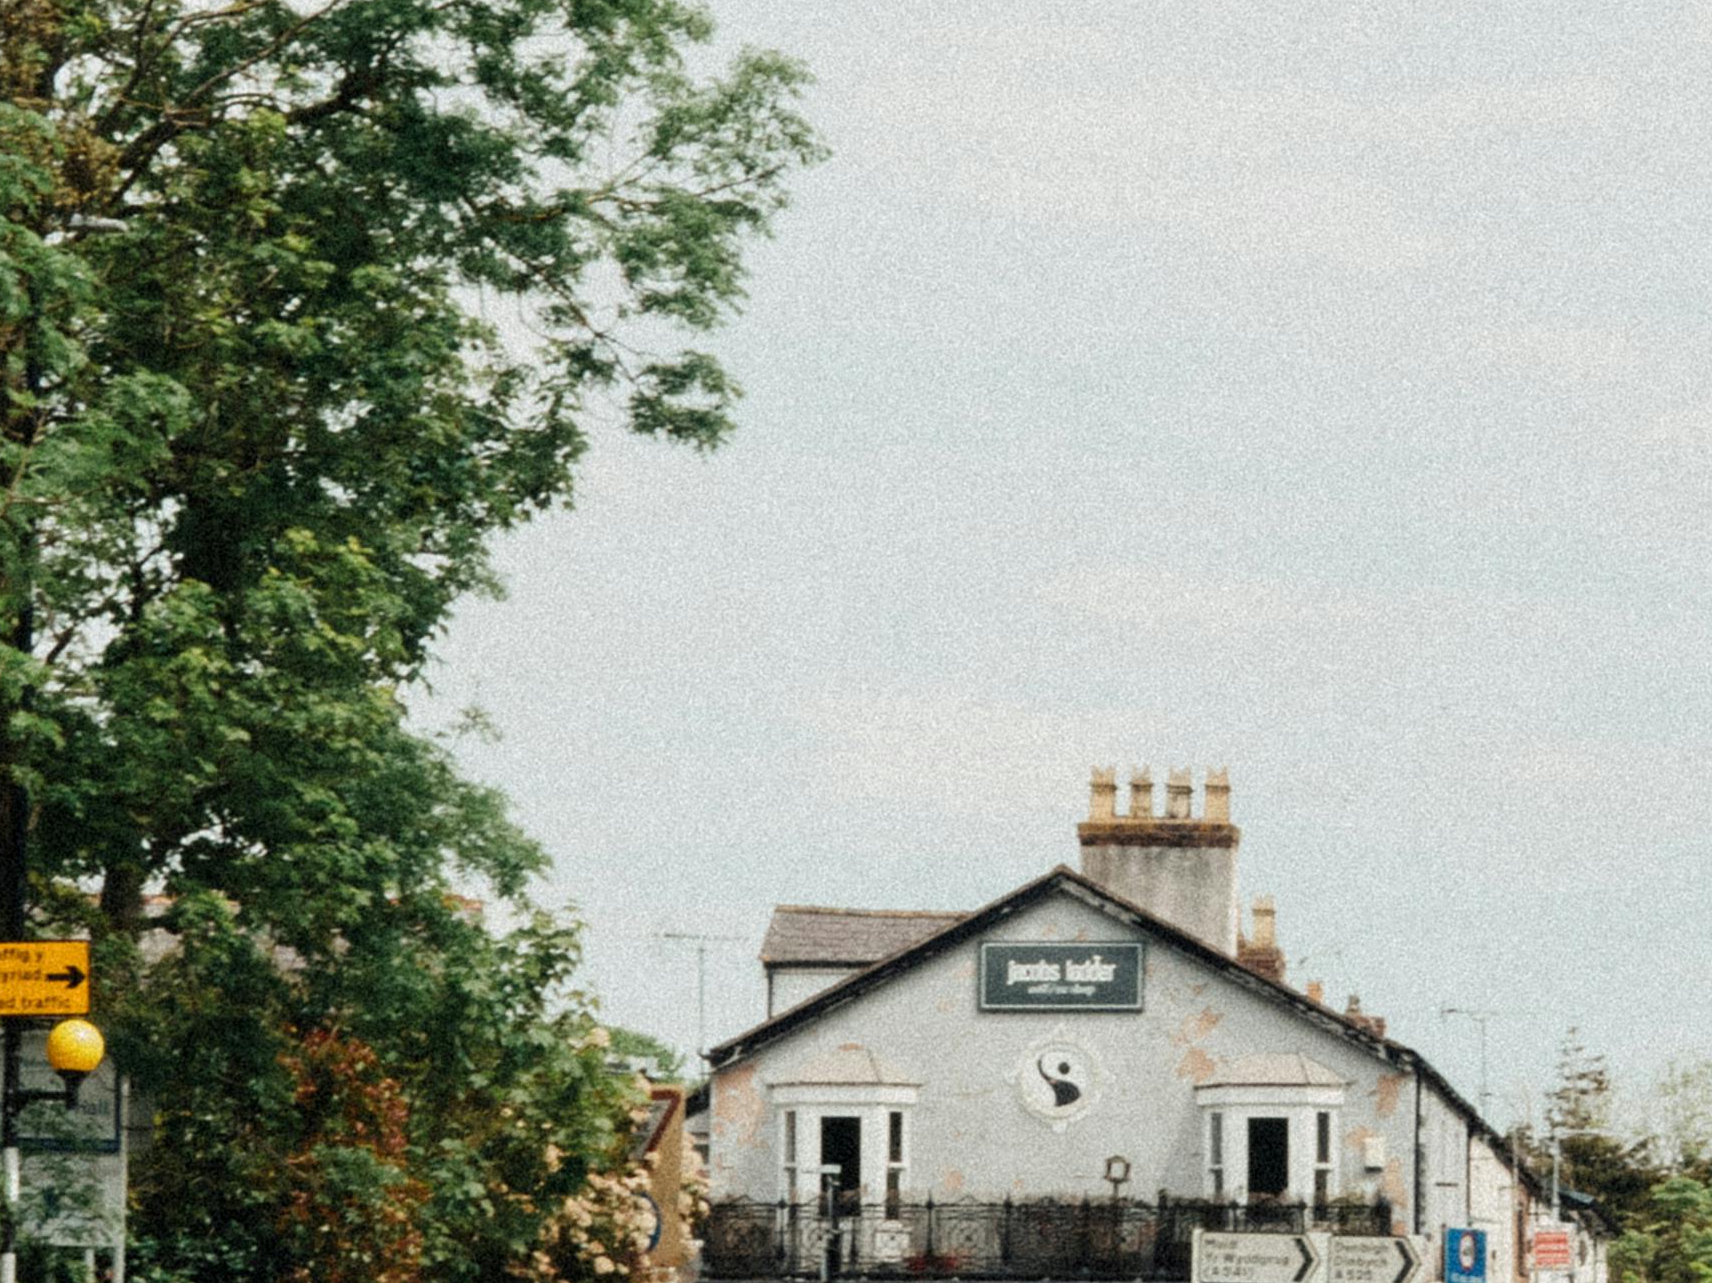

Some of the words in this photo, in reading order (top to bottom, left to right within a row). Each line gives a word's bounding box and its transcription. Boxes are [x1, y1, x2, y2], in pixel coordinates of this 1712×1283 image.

[1006, 959, 1061, 986] jacobs
[1065, 955, 1117, 982] ladder
[20, 995, 72, 1010] traffic
